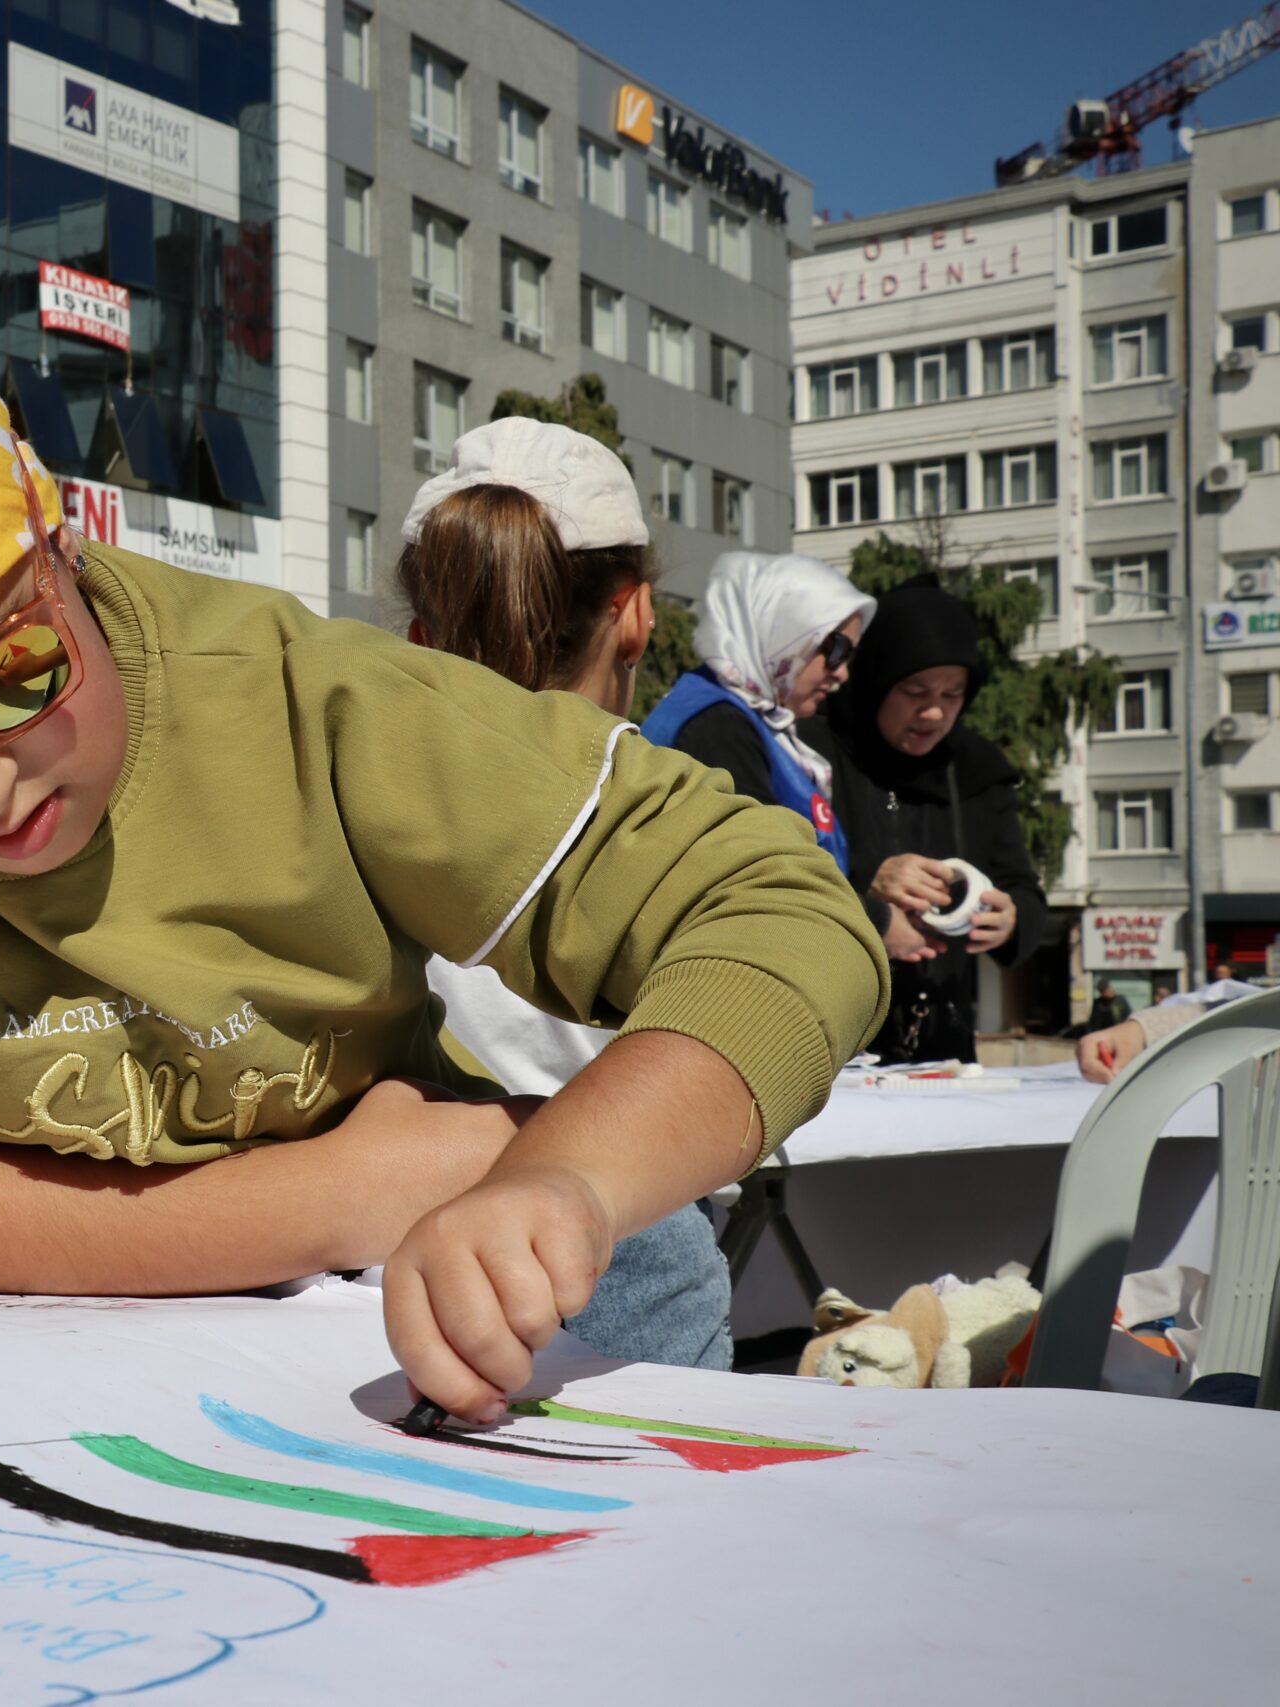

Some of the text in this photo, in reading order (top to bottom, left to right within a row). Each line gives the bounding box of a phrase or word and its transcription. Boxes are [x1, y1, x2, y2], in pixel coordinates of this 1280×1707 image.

[108, 98, 190, 144] AXA HAYAT
[863, 223, 977, 263] OTEL
[158, 525, 237, 559] SAMSUN
